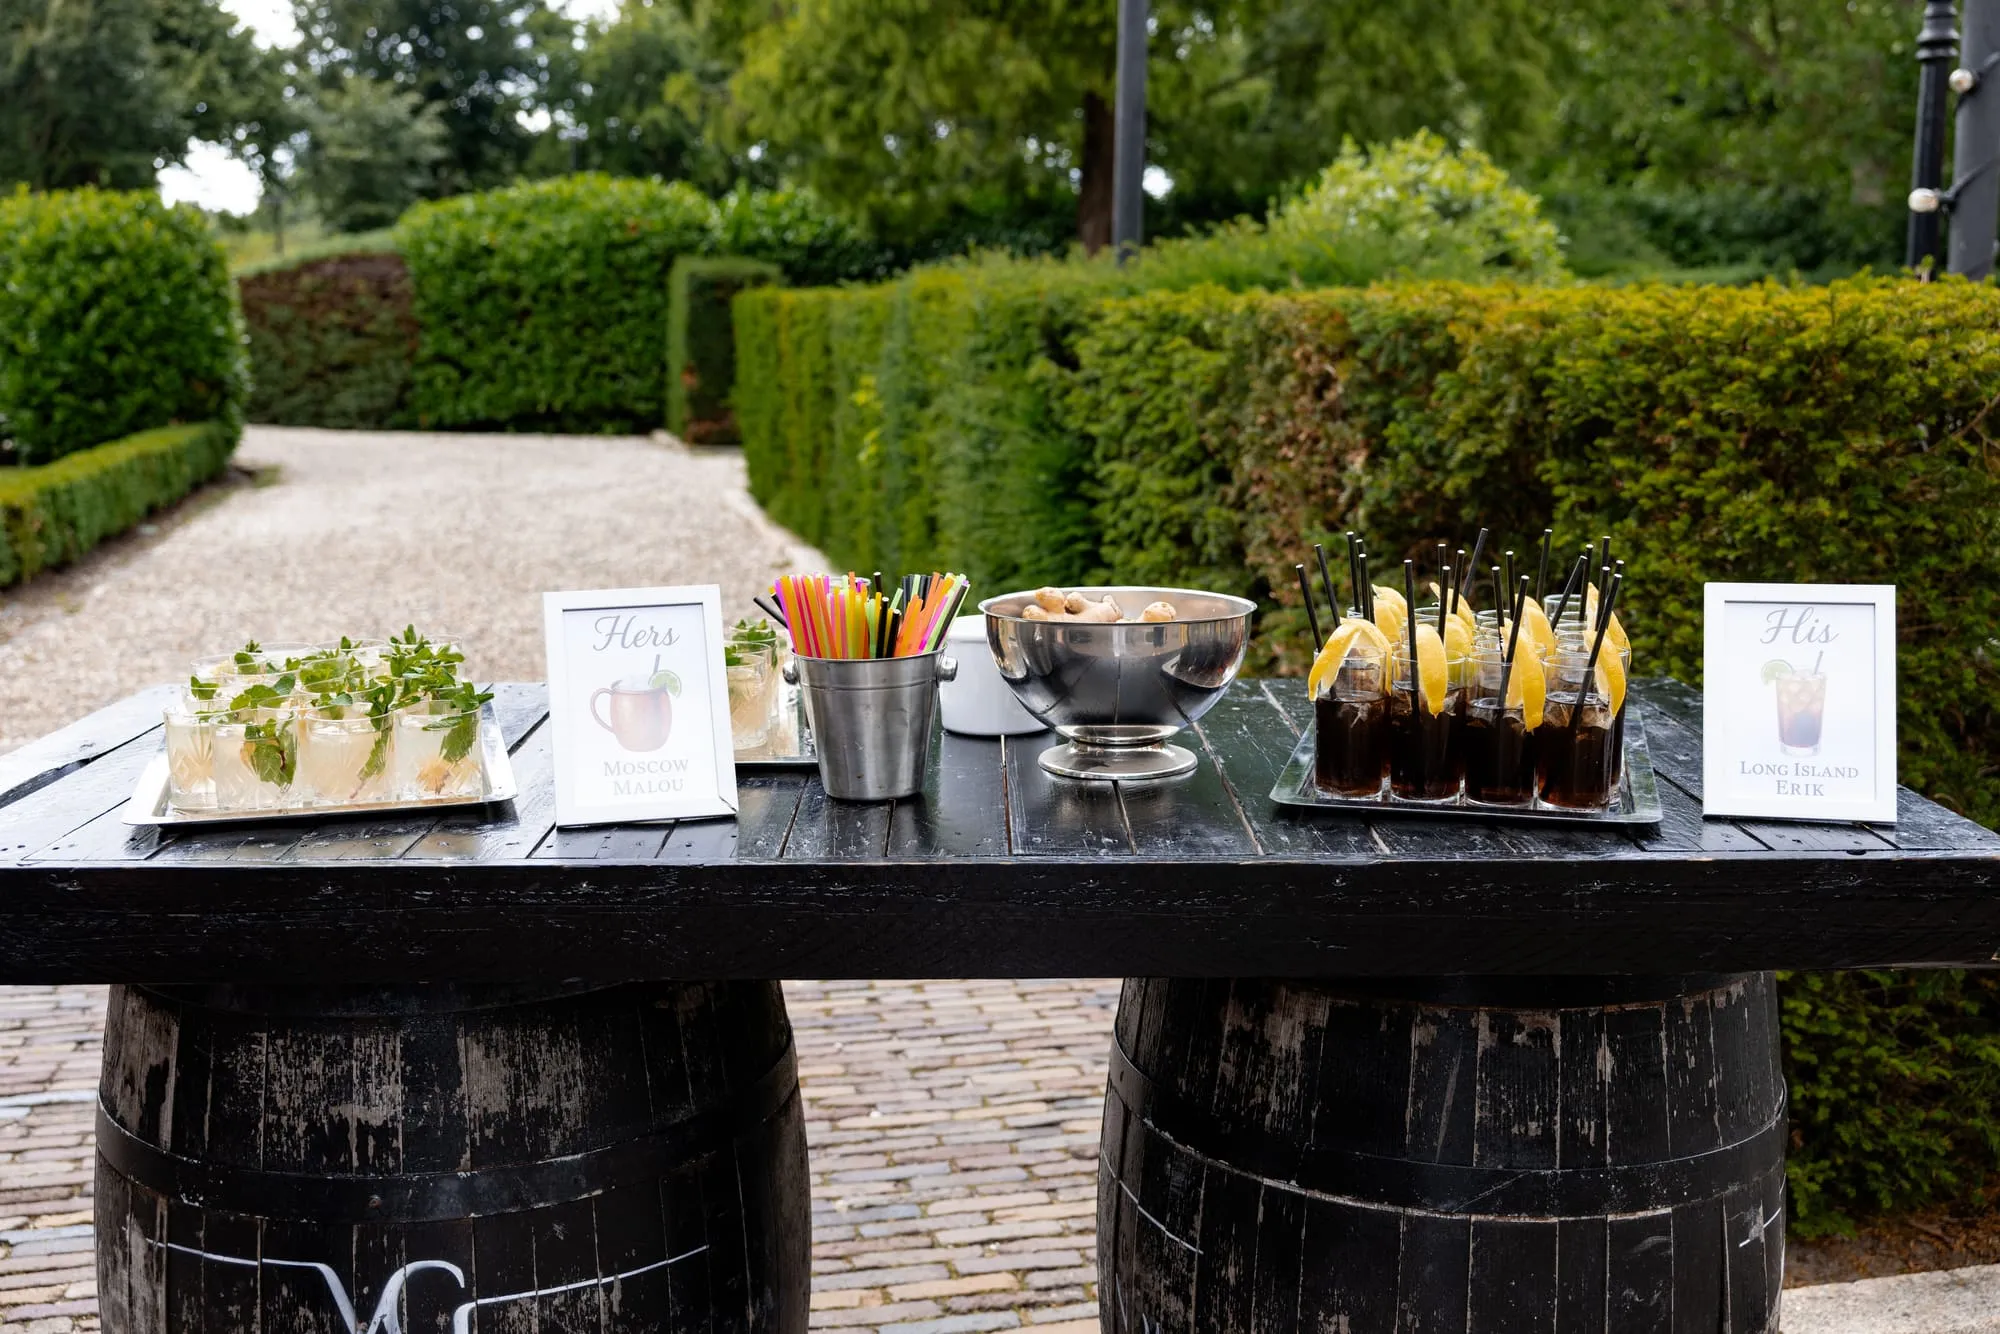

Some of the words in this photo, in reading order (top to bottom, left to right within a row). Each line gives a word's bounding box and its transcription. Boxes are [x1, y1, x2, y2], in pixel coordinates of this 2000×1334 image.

[593, 614, 681, 651] Hers
[1760, 606, 1840, 644] His
[603, 759, 689, 777] MOSCOW
[1740, 761, 1789, 776] LONG
[1794, 762, 1859, 779] ISLAND
[613, 778, 684, 796] MALOU
[1776, 779, 1825, 797] ERIK
